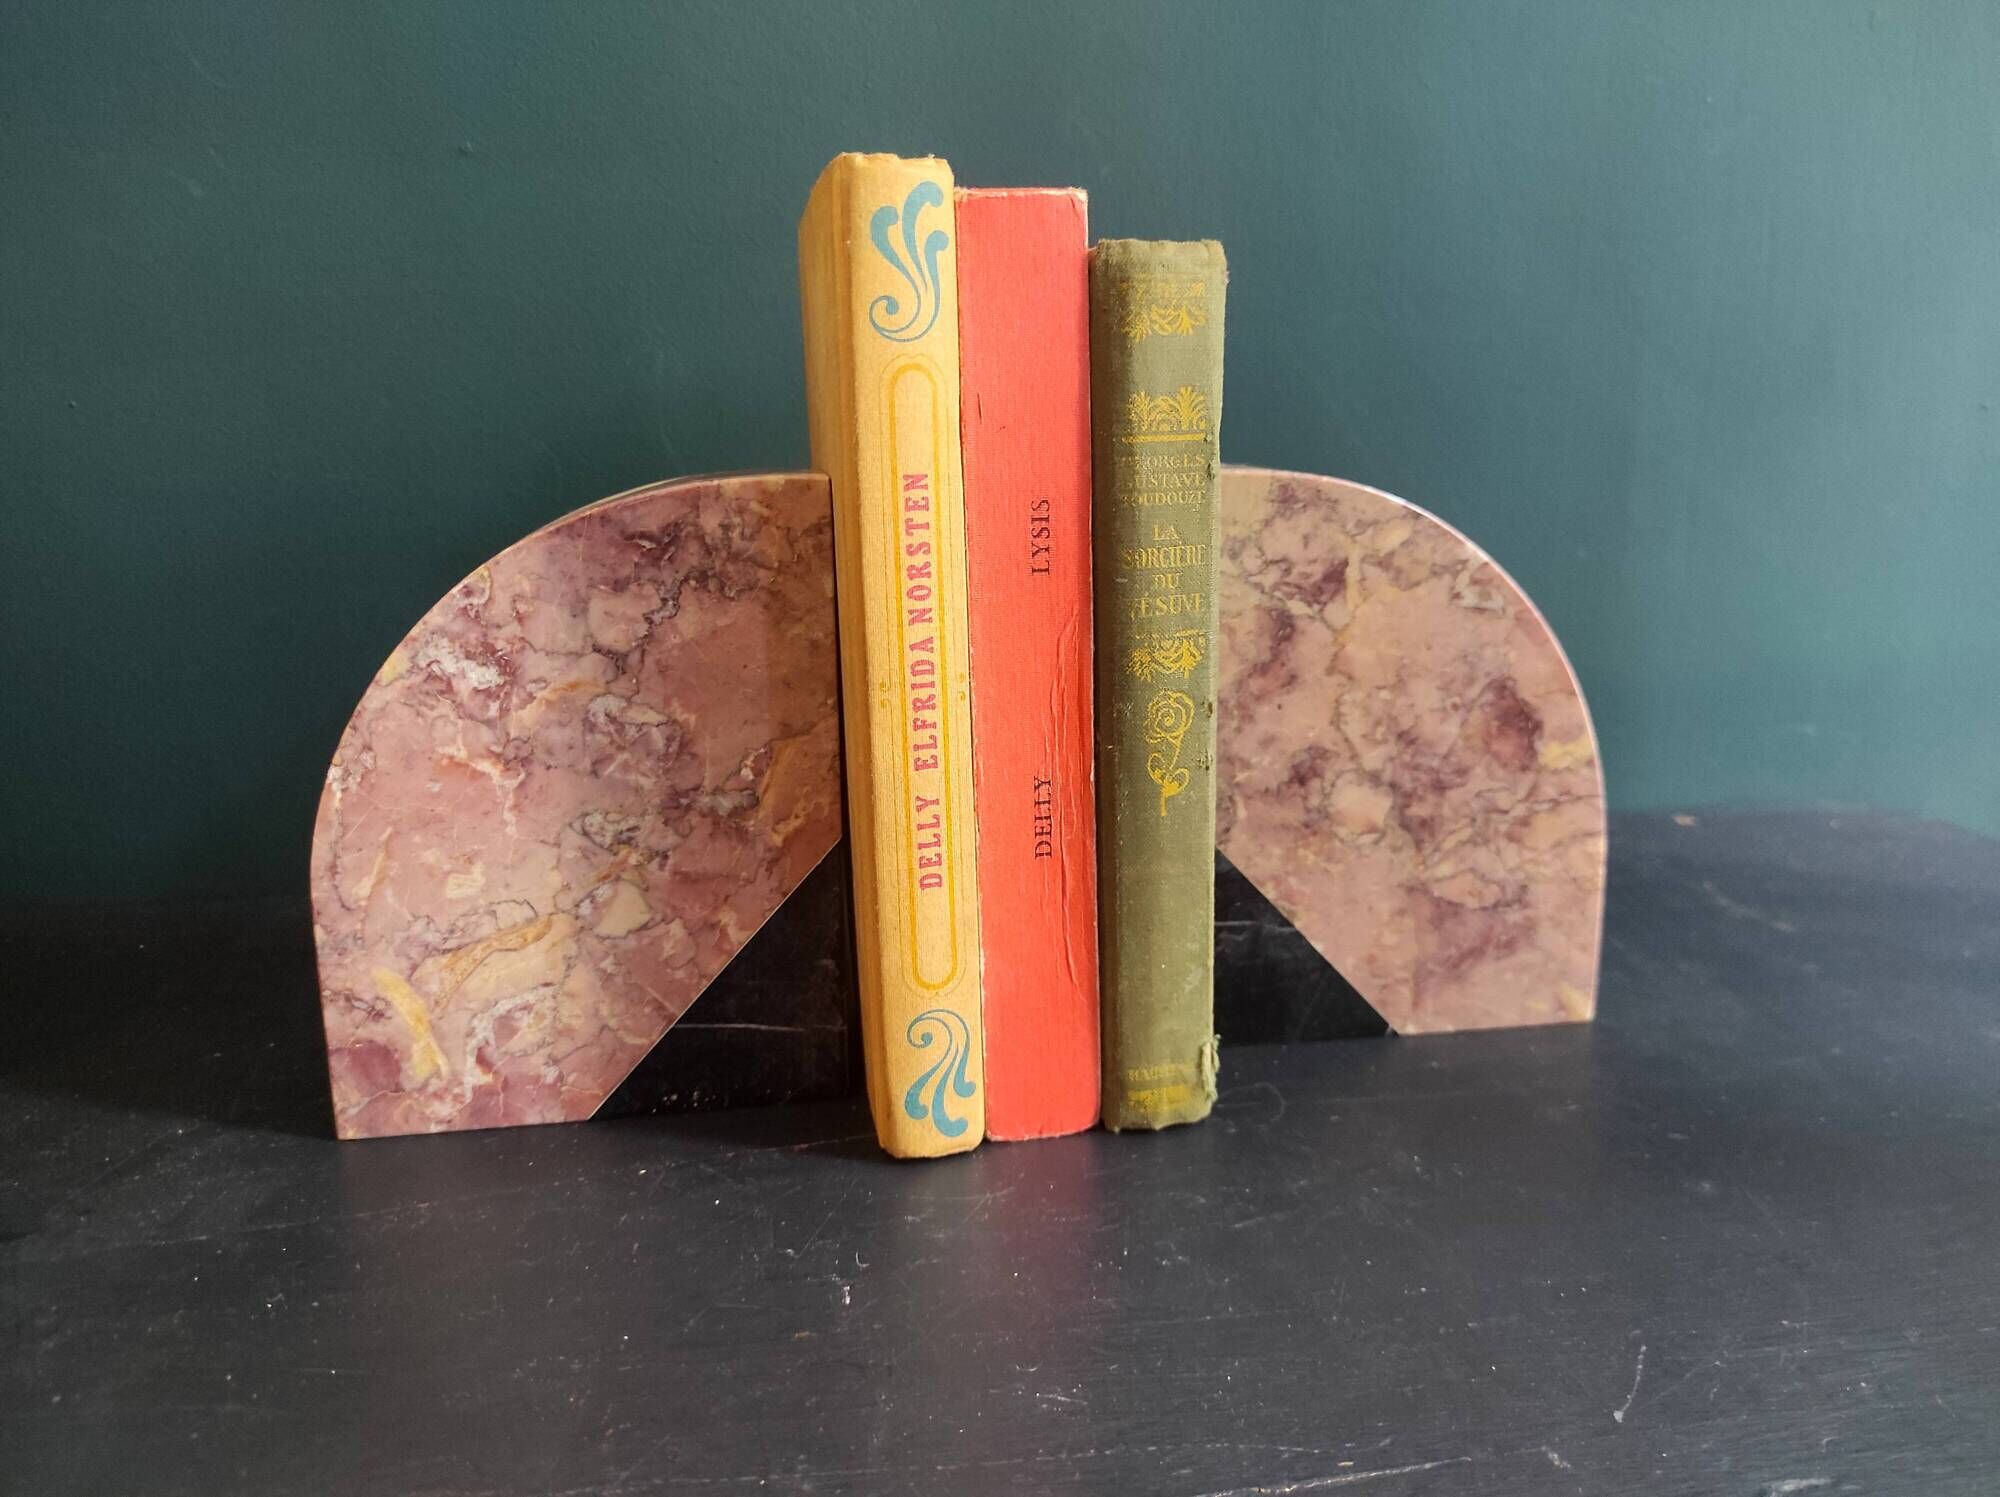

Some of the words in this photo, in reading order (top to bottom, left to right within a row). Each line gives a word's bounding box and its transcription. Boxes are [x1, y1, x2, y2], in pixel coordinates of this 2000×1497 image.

[904, 473, 933, 625] NORSTEN
[1031, 498, 1050, 576] LYSIS
[1152, 524, 1179, 541] LA
[1152, 572, 1182, 588] DU
[909, 637, 939, 771] ELFRIDA
[919, 796, 943, 891] DELLY
[1034, 775, 1053, 860] DELLY
